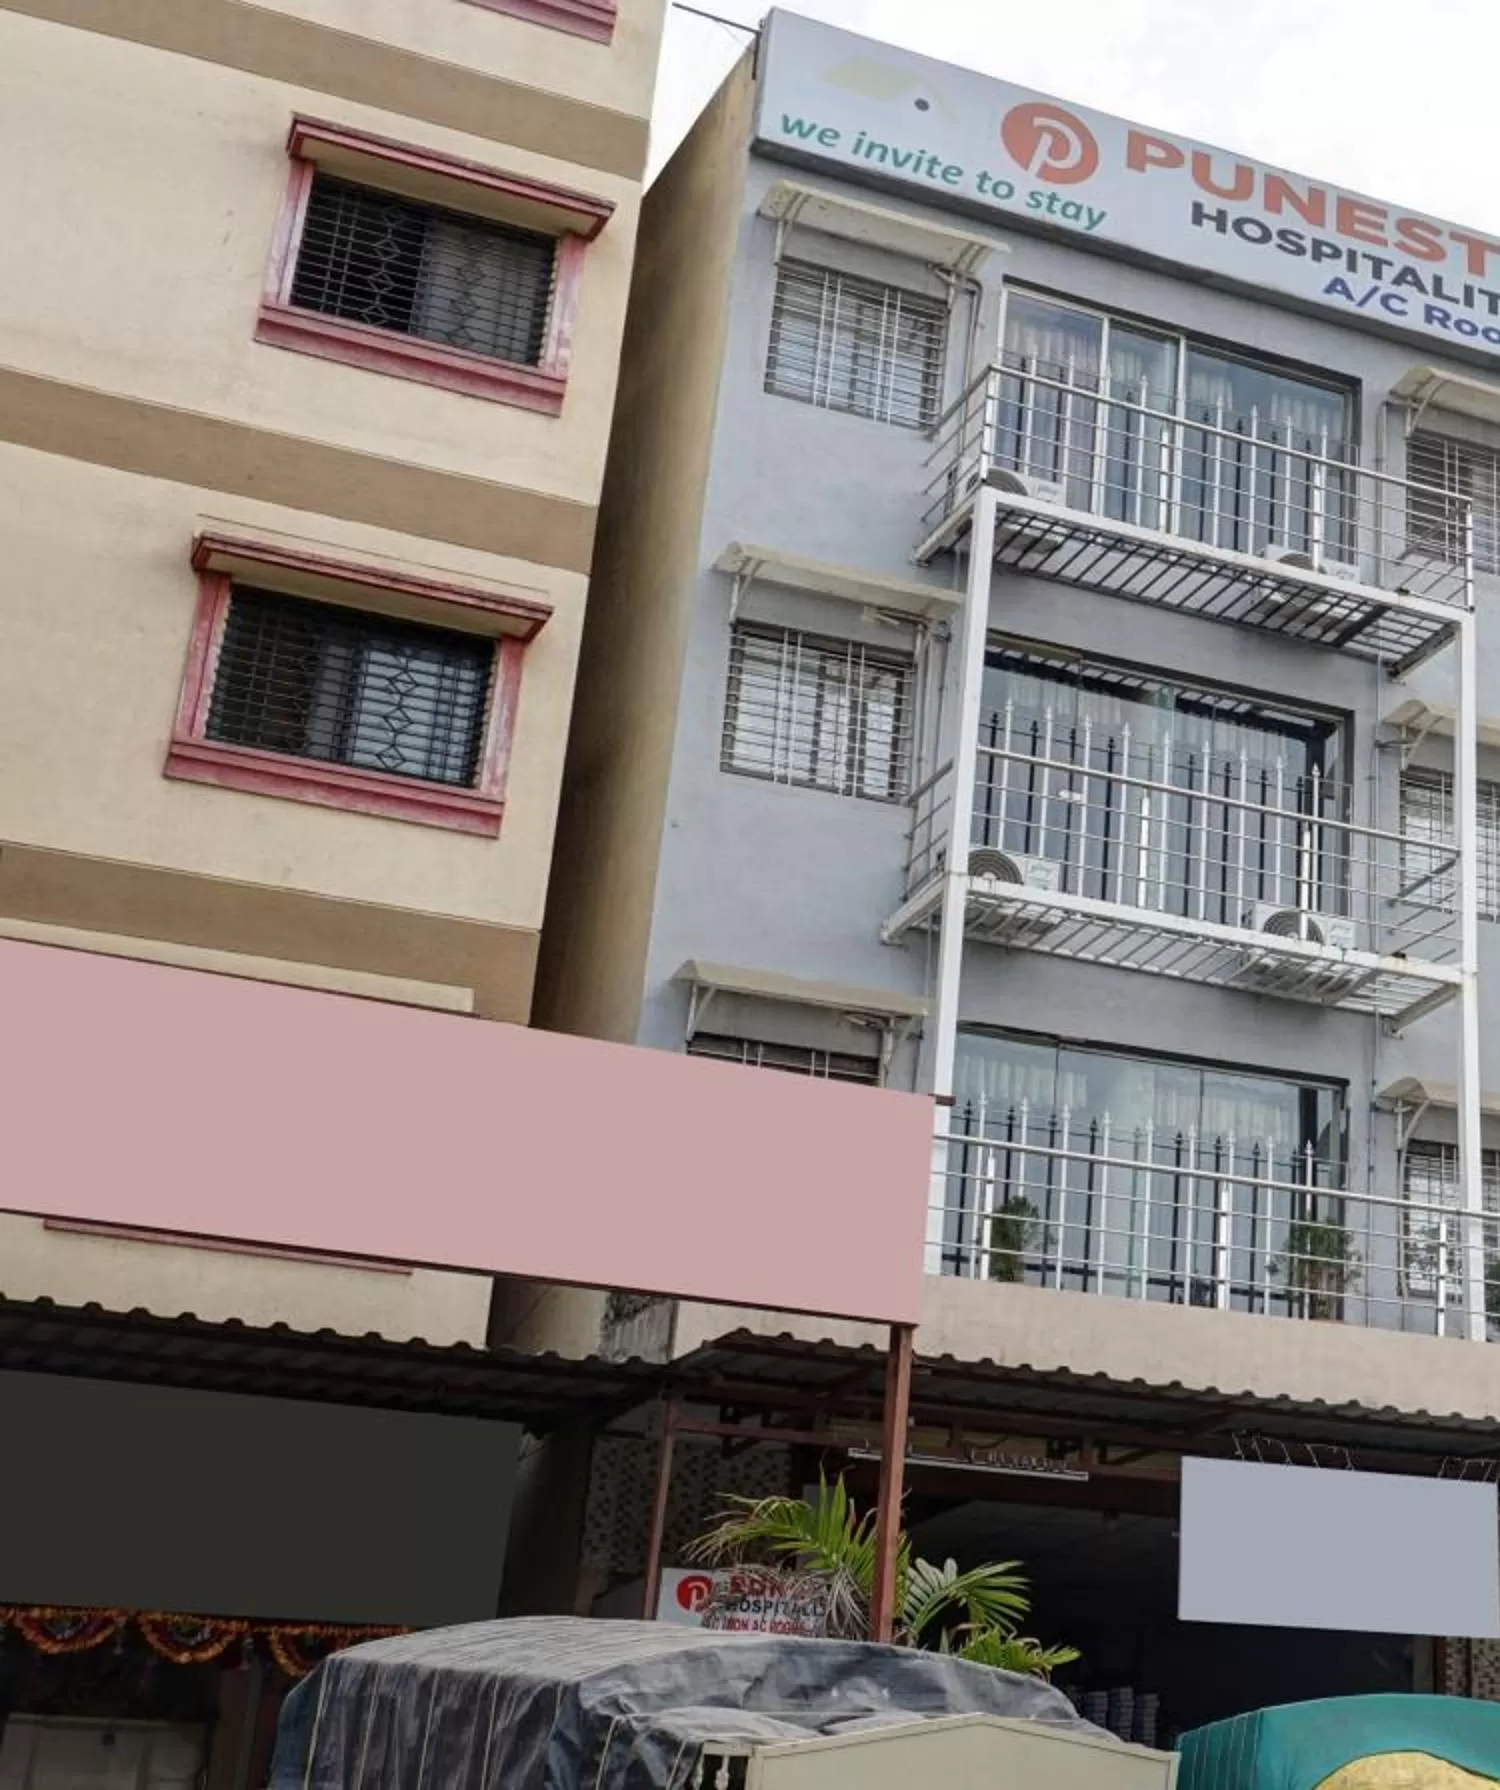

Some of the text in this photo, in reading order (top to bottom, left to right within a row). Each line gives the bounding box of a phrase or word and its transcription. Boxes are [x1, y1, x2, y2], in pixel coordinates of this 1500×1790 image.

[781, 111, 1108, 231] we invite to stay
[1322, 277, 1409, 318] A/C
